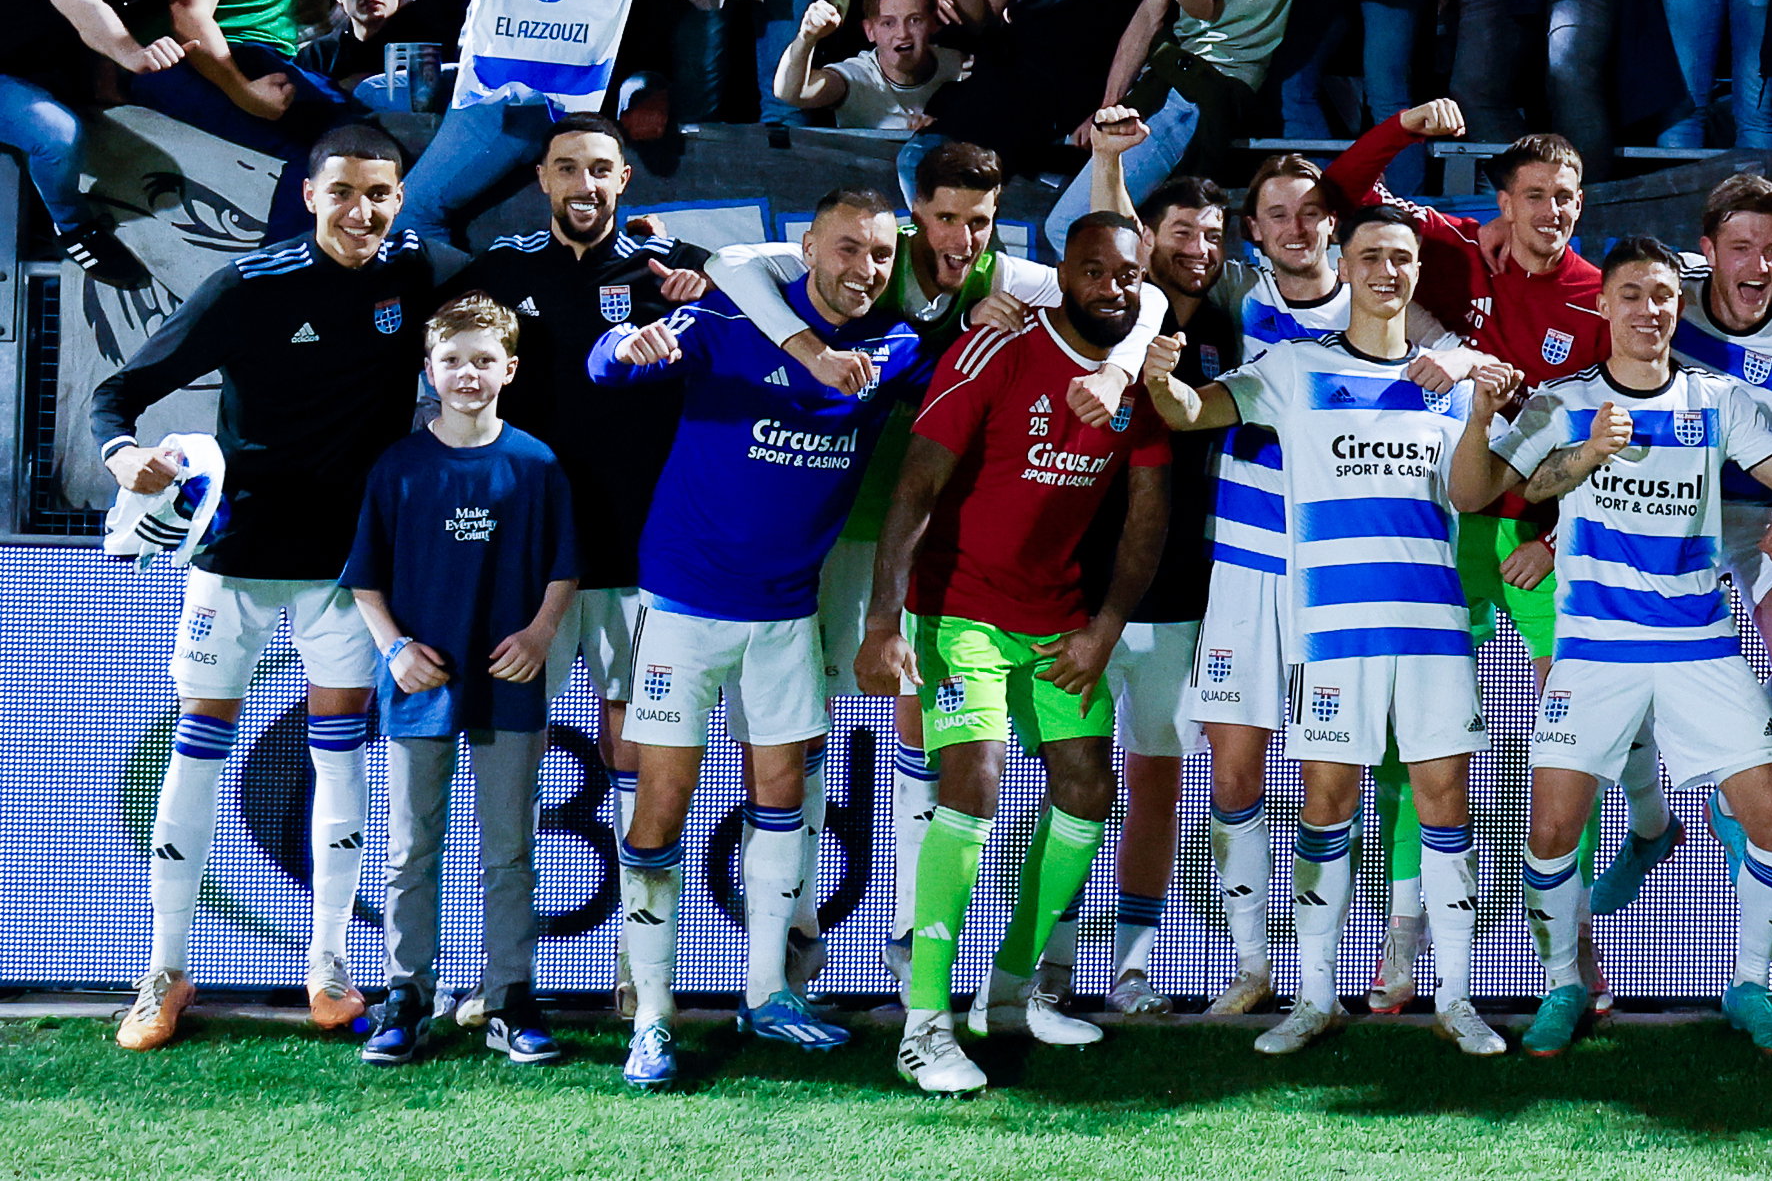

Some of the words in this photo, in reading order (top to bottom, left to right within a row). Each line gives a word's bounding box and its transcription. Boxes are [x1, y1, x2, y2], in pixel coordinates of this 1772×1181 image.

[495, 16, 517, 38] EL
[519, 17, 590, 45] AZZOUZI
[1028, 416, 1049, 436] 25
[752, 419, 857, 453] Circus.nl
[748, 446, 793, 465] SPORT
[794, 454, 803, 467] &
[807, 453, 851, 470] CASINO
[1027, 443, 1114, 474] Circus.nl
[1332, 434, 1441, 466] Circus.nl
[1021, 468, 1057, 486] SPORT
[1057, 475, 1064, 486] &
[1336, 464, 1378, 478] SPORT
[1382, 464, 1393, 476] &
[456, 507, 489, 519] Make
[1593, 492, 1628, 511] PORT
[1632, 500, 1642, 514] &
[1646, 501, 1698, 517] CASINO
[445, 518, 497, 532] Everyday
[455, 529, 489, 542] Count
[1201, 690, 1241, 702] QUADES
[636, 707, 681, 723] QUADES
[935, 713, 979, 731] QUADES
[1304, 728, 1350, 742] QUADES
[1535, 731, 1577, 745] QUADES
